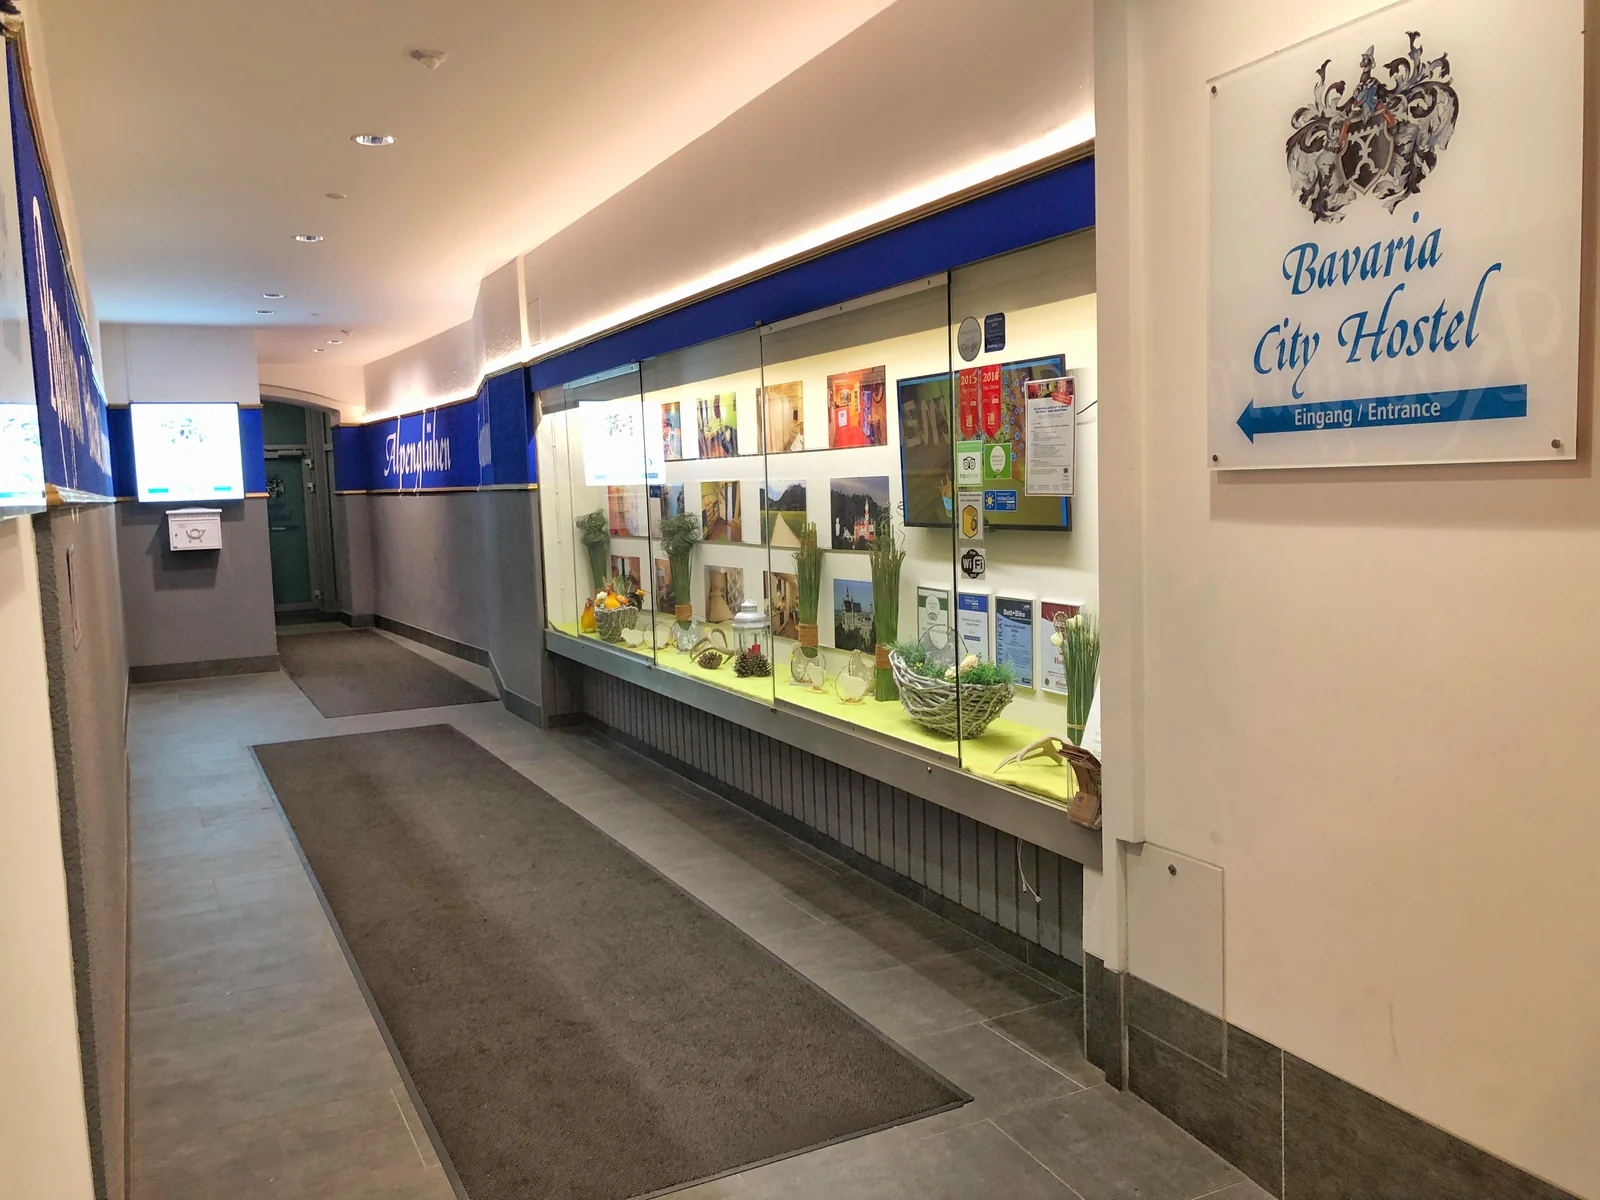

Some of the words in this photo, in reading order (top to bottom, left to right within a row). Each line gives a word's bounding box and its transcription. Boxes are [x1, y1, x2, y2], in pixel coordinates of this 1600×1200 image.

[1282, 211, 1442, 296] Bavaria
[1253, 317, 1320, 400] City
[1337, 263, 1502, 364] Hostel
[961, 370, 978, 385] 2015
[983, 368, 999, 382] 2016
[1294, 406, 1353, 429] Eingang
[1357, 404, 1364, 423] /
[1368, 400, 1441, 420] Entrance
[384, 407, 451, 497] Alpenglühen
